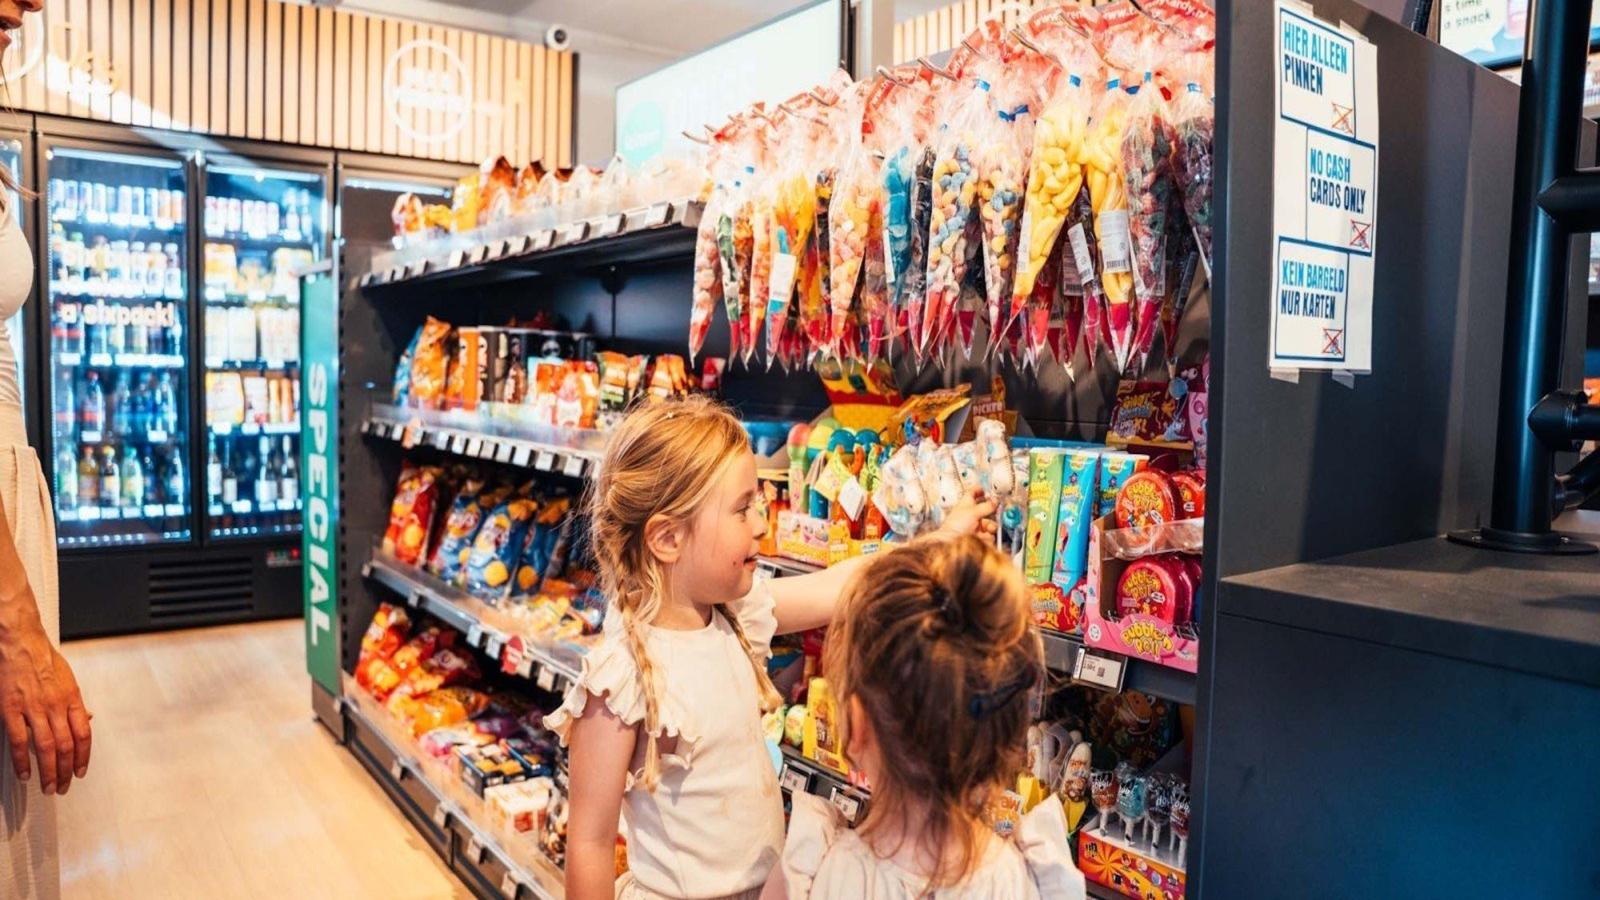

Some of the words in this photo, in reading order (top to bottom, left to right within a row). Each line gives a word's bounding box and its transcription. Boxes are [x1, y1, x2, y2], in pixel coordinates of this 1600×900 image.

[1284, 21, 1309, 58] HIER
[1311, 33, 1347, 74] ALLEEN
[1284, 53, 1323, 95] PINNEN
[1310, 148, 1323, 176] NO
[1326, 152, 1351, 183] CASH
[1310, 176, 1341, 208] CARDS
[1344, 185, 1366, 214] ONLY
[1282, 259, 1305, 287] KEIN
[1306, 263, 1345, 293] BARGELD
[1280, 289, 1301, 316] NUR
[1302, 292, 1336, 320] KARTEN
[308, 362, 330, 646] SPECIAL
